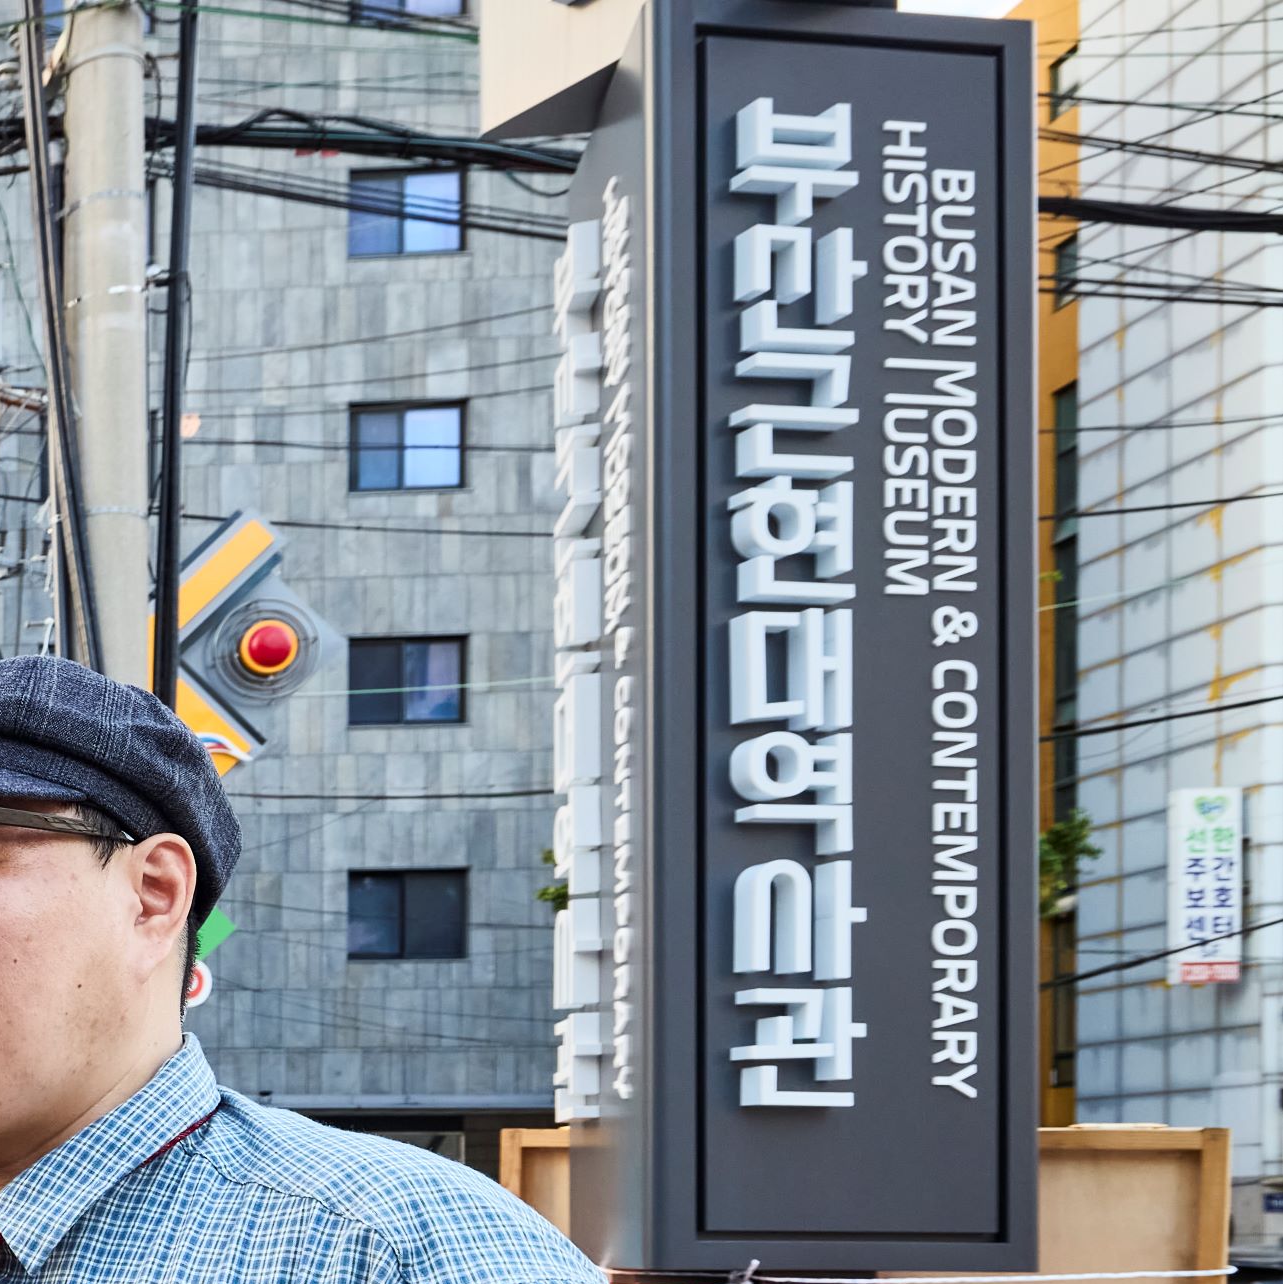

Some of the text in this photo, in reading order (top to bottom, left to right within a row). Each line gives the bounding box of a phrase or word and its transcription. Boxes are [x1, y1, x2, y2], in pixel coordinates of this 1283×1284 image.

[730, 97, 866, 1107] 부산근현대역사관
[882, 119, 930, 346] HISTORY
[931, 168, 979, 1099] BUSAN MODERN & CONTEMPORARY
